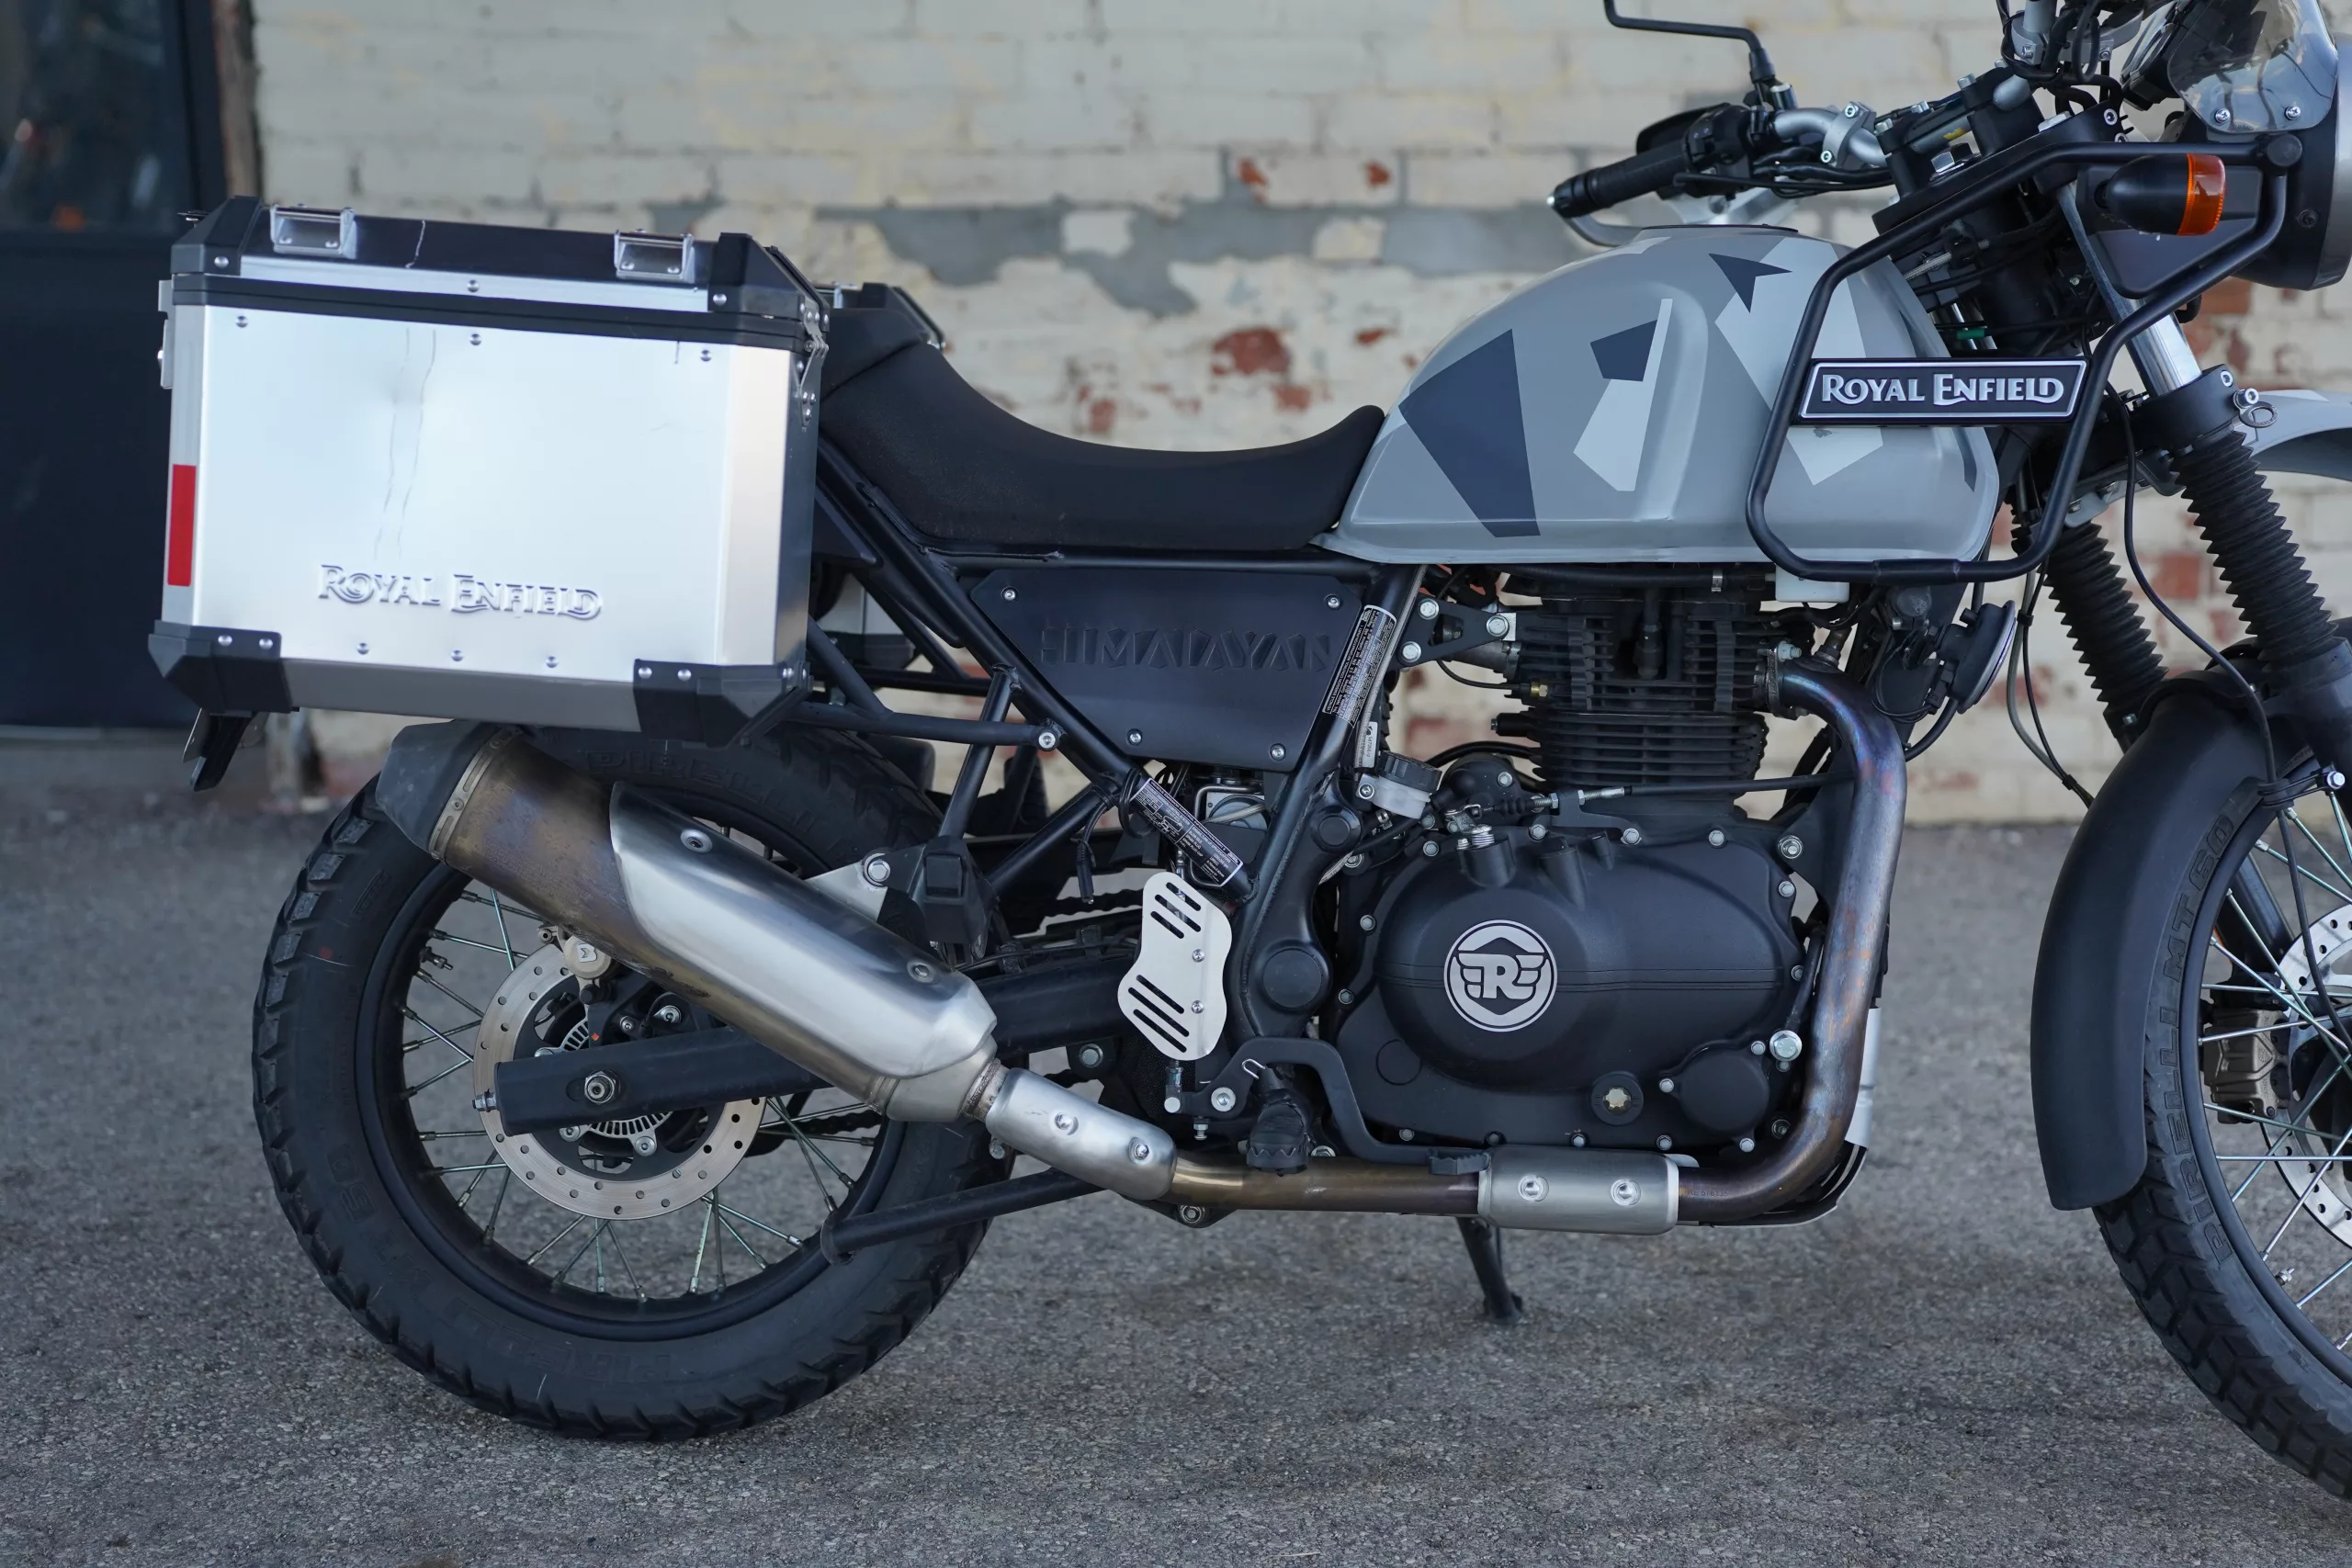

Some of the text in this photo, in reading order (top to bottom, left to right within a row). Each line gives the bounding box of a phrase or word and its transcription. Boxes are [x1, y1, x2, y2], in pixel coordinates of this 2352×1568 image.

[1822, 373, 2064, 406] ROYAL ENFIELD
[318, 564, 603, 621] ROYAL ENFIELD
[1036, 626, 1336, 672] HIMALAYAN
[2159, 1006, 2233, 1265] PIRELLI
